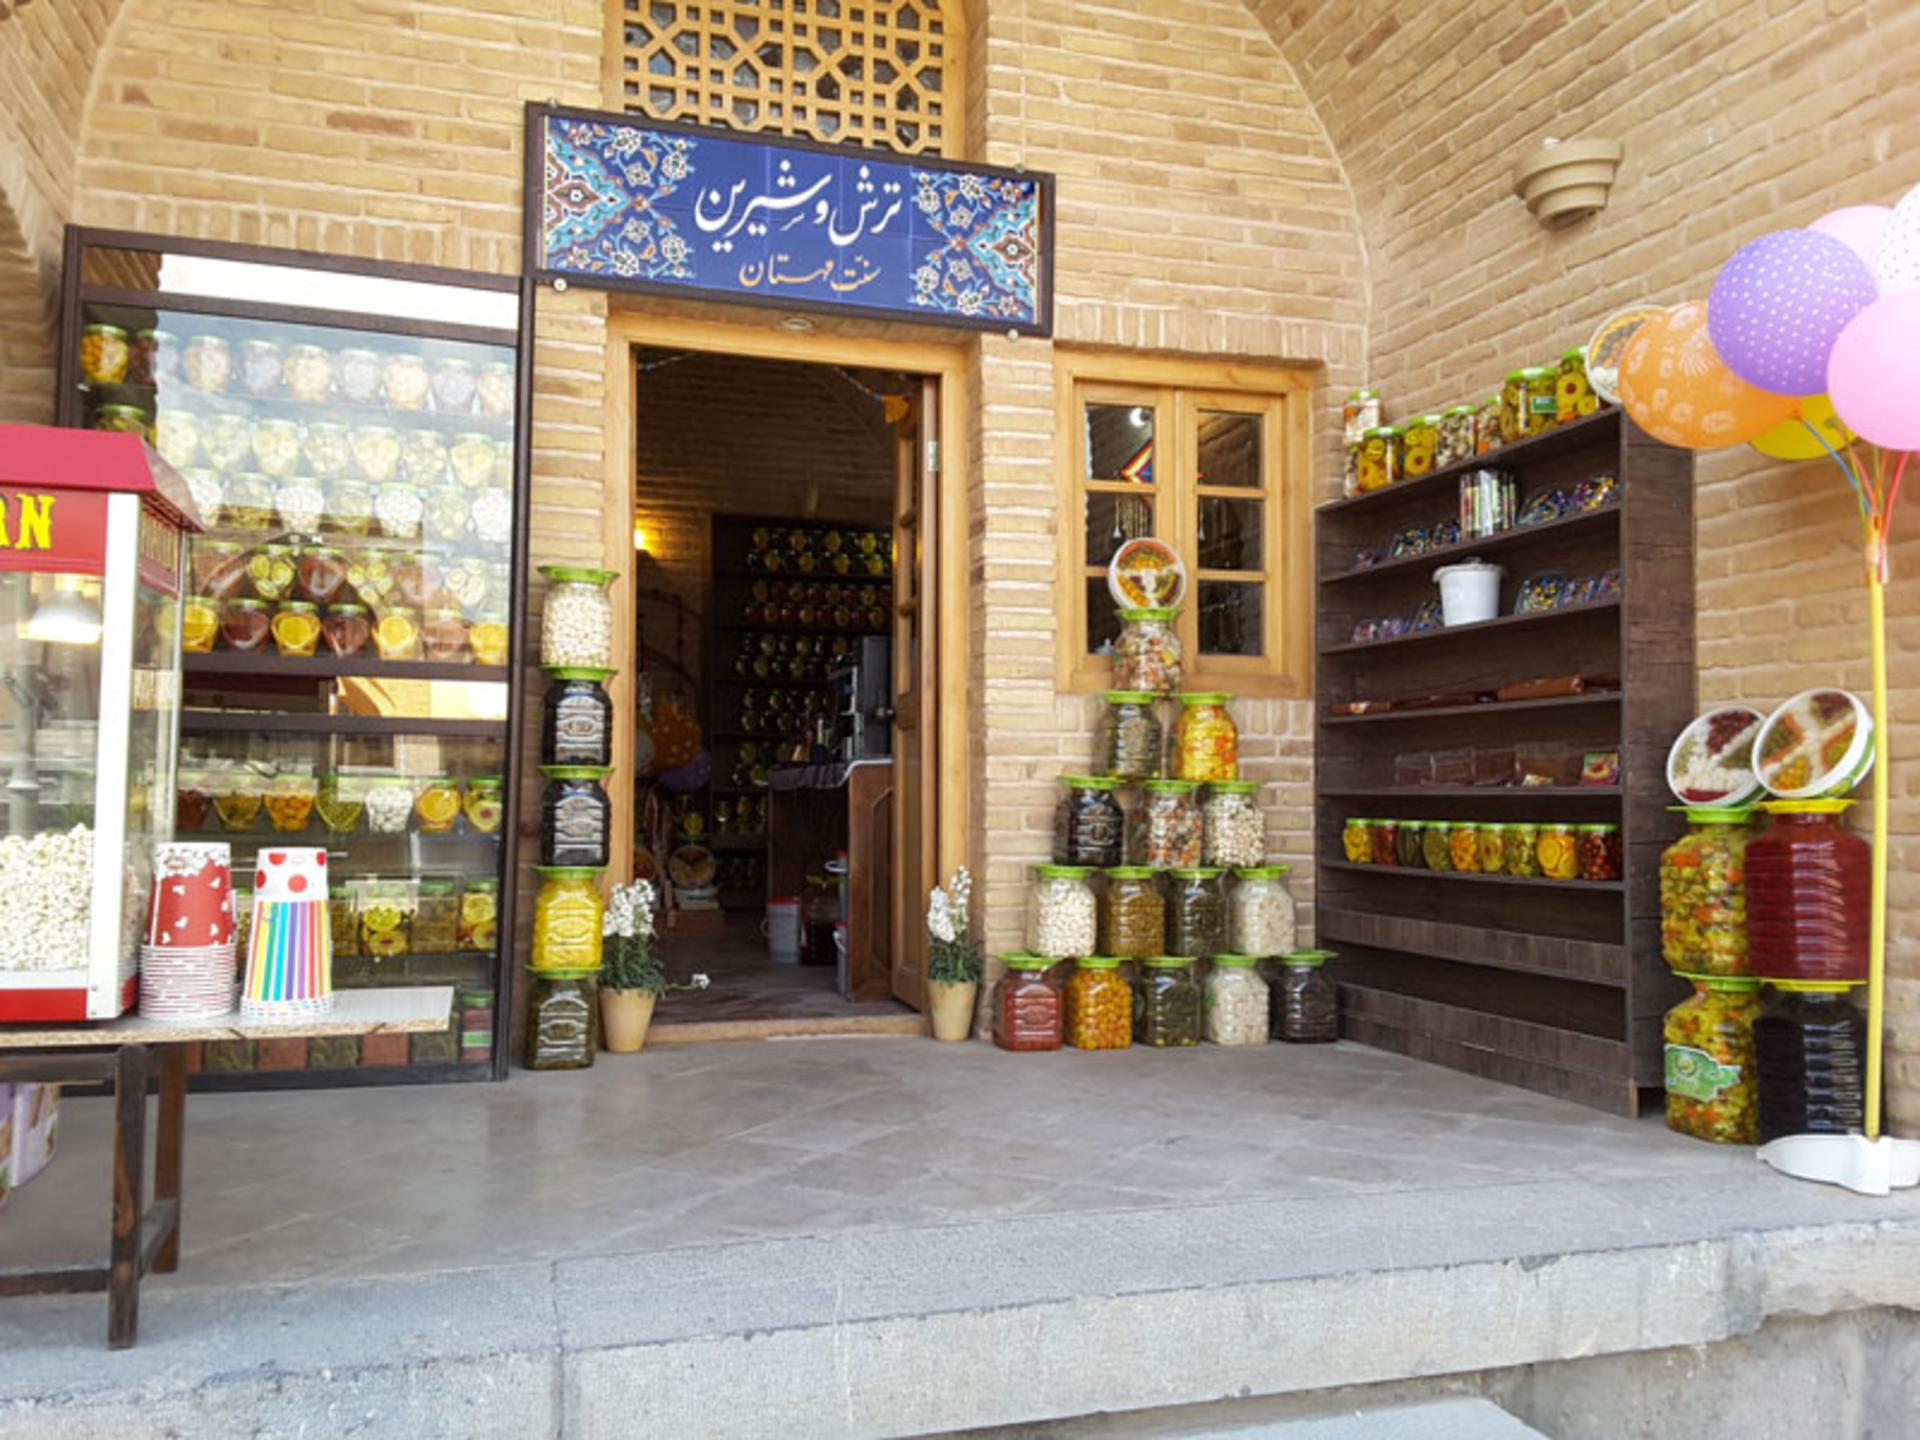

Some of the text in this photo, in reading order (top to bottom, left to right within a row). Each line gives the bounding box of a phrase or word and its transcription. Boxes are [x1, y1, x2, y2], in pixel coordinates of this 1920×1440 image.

[694, 160, 903, 253] ترش و شیرین
